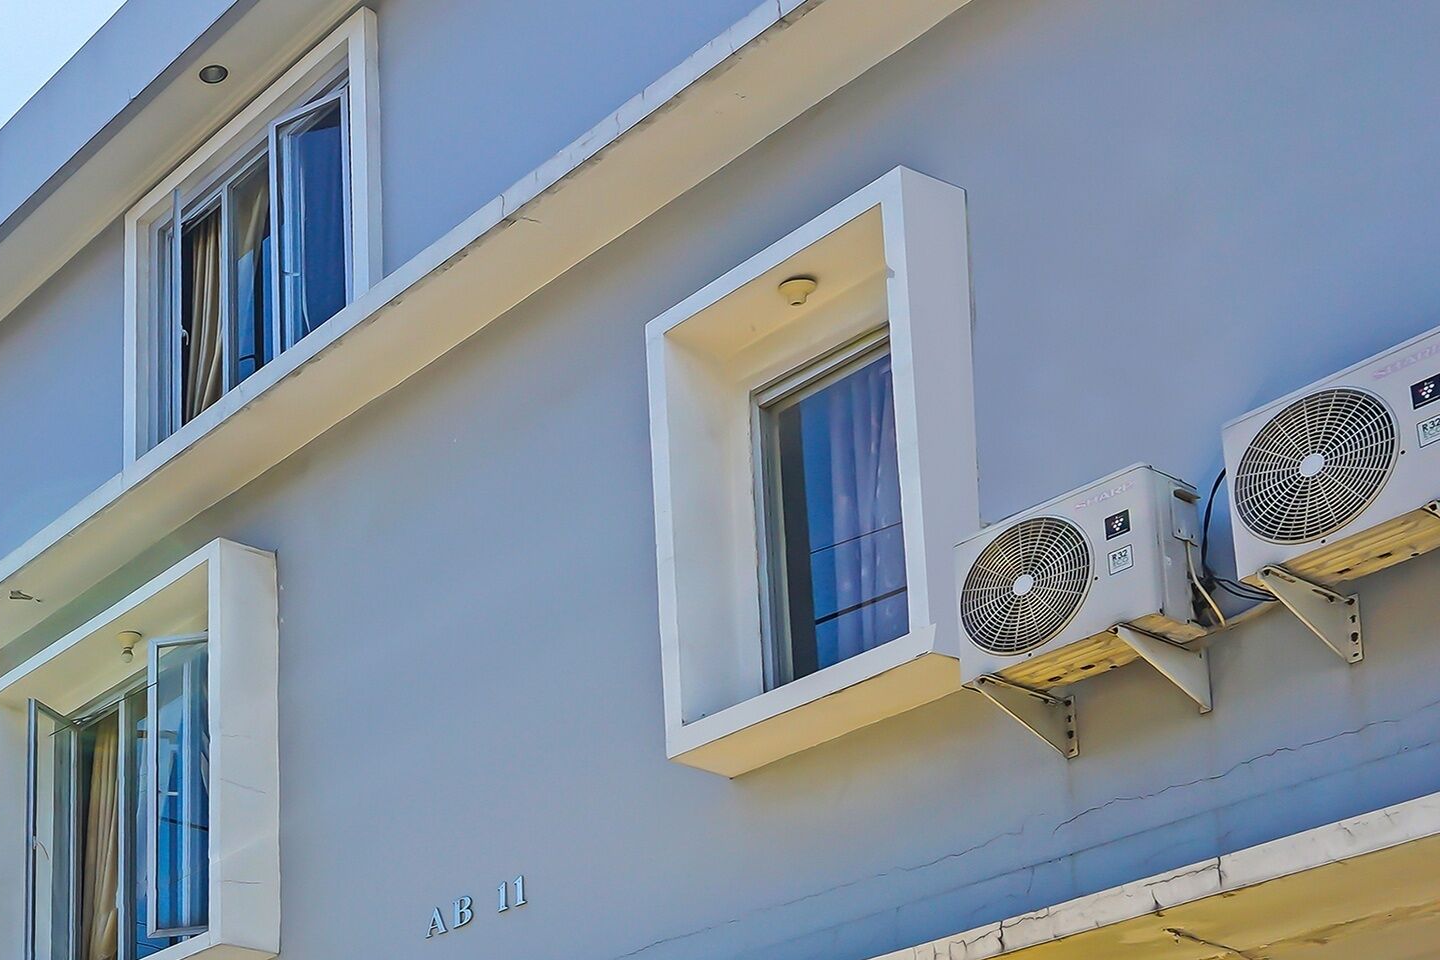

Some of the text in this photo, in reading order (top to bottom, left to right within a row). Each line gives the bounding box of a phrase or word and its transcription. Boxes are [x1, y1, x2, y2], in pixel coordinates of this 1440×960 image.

[1074, 480, 1136, 511] SHARP
[1111, 549, 1128, 560] R32
[425, 875, 528, 939] AB 11
